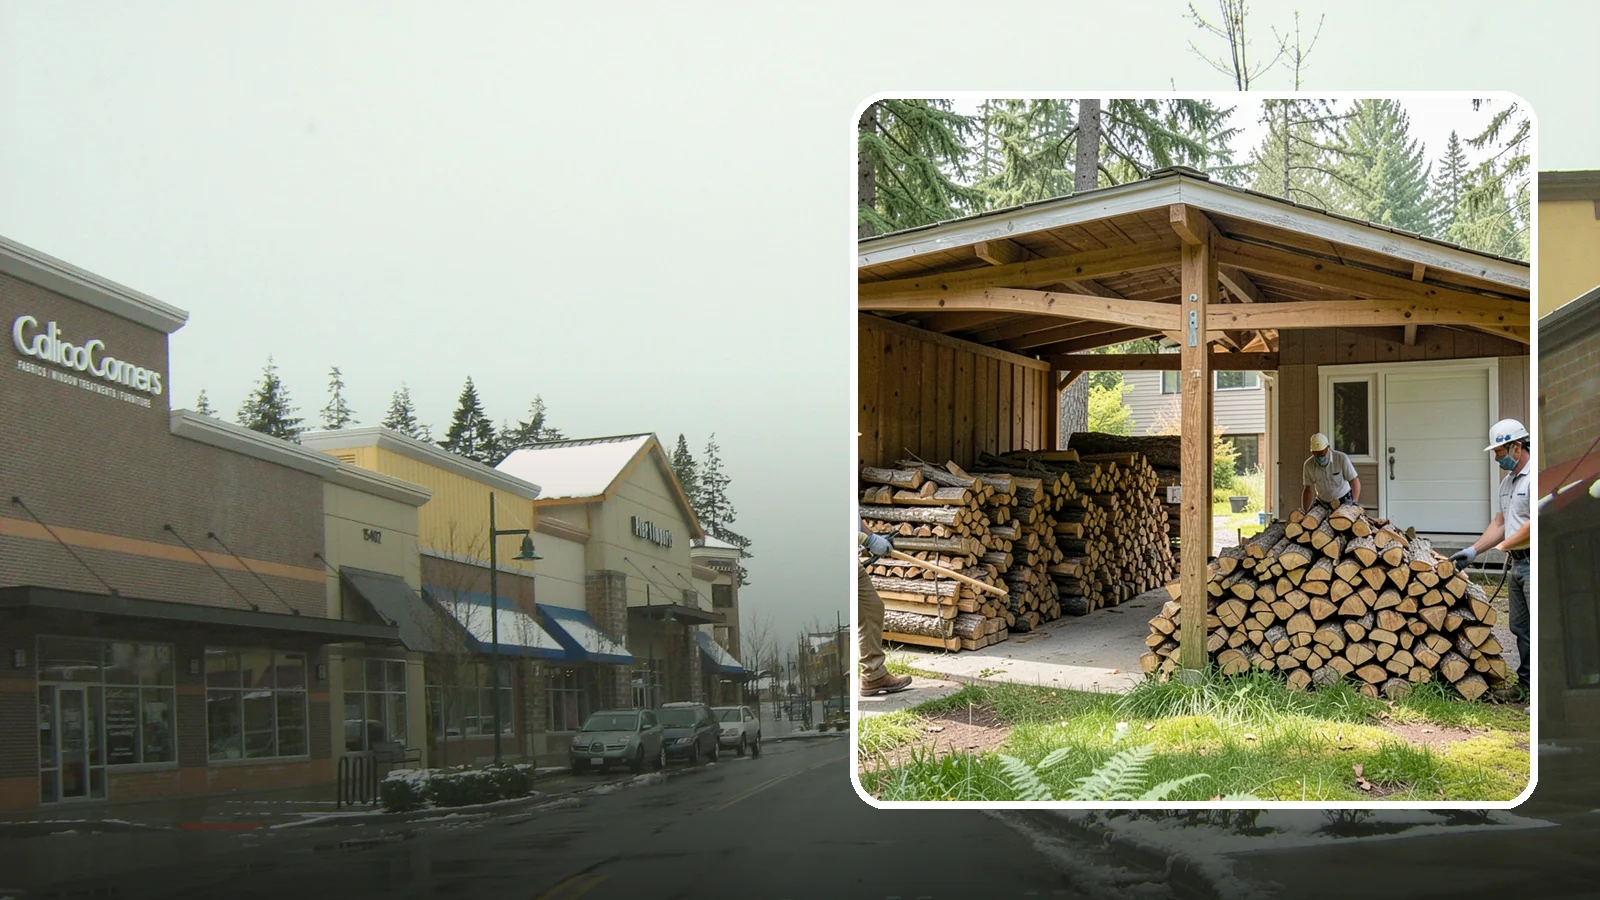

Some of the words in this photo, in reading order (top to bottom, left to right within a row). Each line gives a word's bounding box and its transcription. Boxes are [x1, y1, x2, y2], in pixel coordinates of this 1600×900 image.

[16, 360, 47, 378] FABRICS
[51, 370, 78, 387] WINDOW
[78, 378, 117, 398] TREATMENTS
[119, 391, 151, 409] FURNITURE
